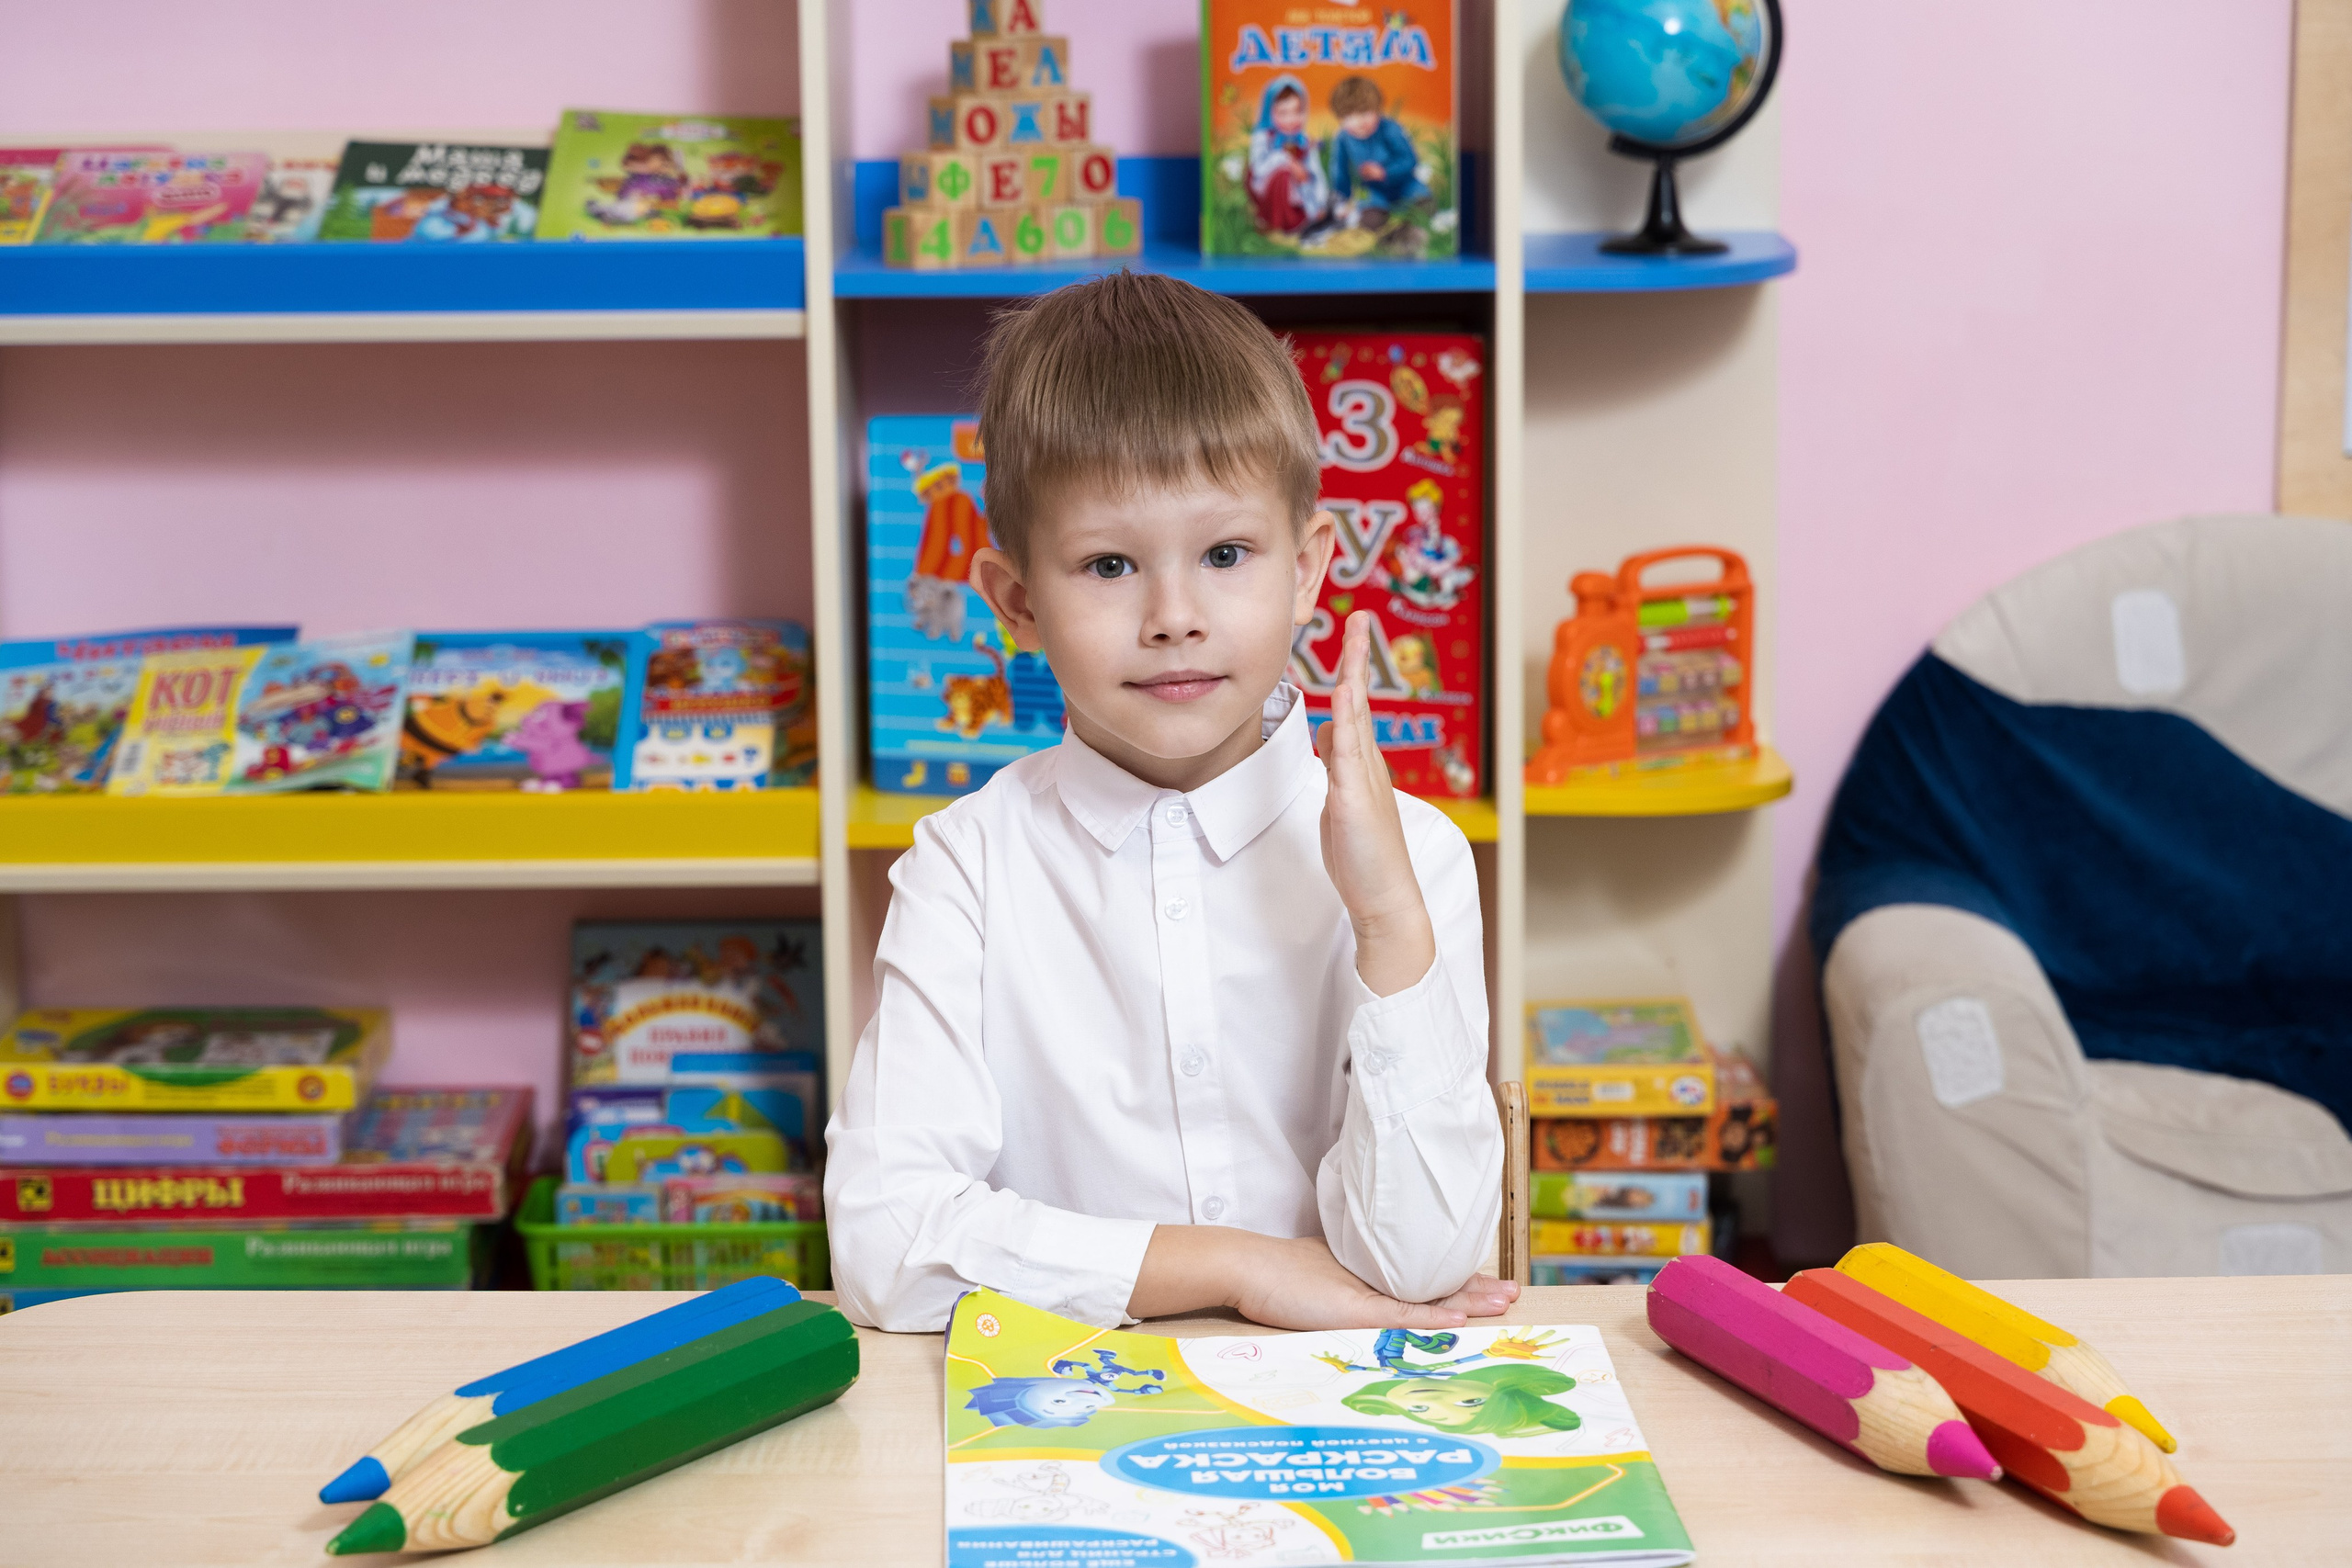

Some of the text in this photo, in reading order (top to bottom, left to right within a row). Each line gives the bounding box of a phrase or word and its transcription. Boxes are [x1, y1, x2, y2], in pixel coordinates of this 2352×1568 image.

[1231, 25, 1435, 72] ДЕТЯМ
[1030, 156, 1059, 197] 7
[919, 218, 952, 262] 4
[1329, 380, 1399, 472] З
[149, 666, 240, 710] КОТ
[93, 1177, 244, 1213] ЦИФРЫ
[1163, 1439, 1304, 1450] подсказкой
[1311, 1438, 1410, 1449] цветной
[1128, 1449, 1473, 1469] РАСКРАСКА
[1191, 1468, 1417, 1483] БОЛЬШАЯ
[1270, 1482, 1345, 1494] МОЯ
[956, 1539, 1159, 1550] РАСКРАШИВАНИЯ
[1016, 1549, 1177, 1559] СТРАНИЦ ДЛЯ
